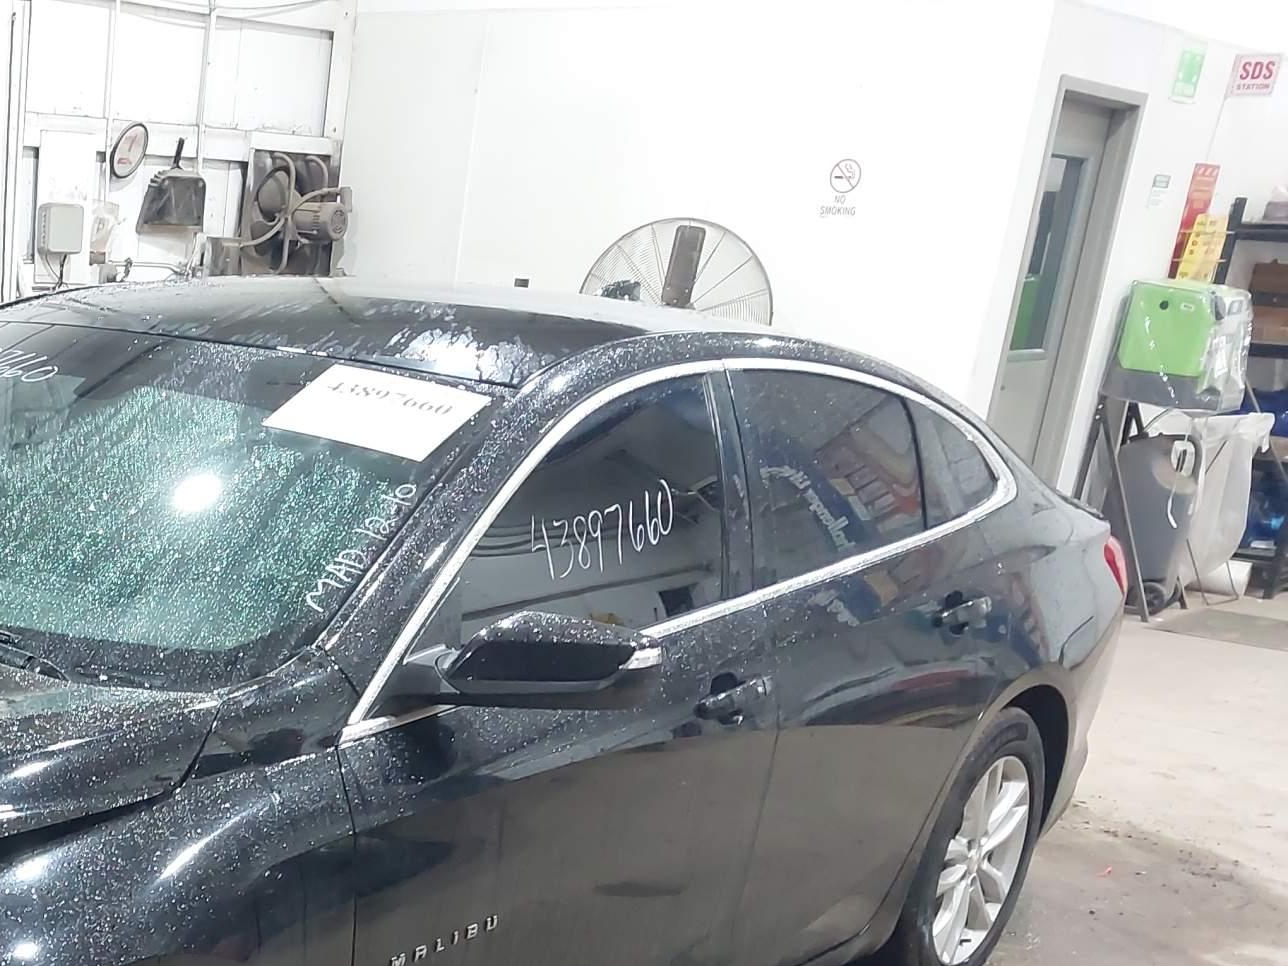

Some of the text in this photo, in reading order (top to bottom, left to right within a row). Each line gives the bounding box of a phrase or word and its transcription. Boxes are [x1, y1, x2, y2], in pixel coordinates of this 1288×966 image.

[1239, 60, 1276, 81] SDS
[1236, 83, 1271, 91] STATION
[834, 195, 846, 204] NO
[819, 206, 857, 216] SMOKING
[327, 381, 454, 417] 43897660
[531, 479, 674, 580] 43897660
[305, 548, 368, 614] MAD
